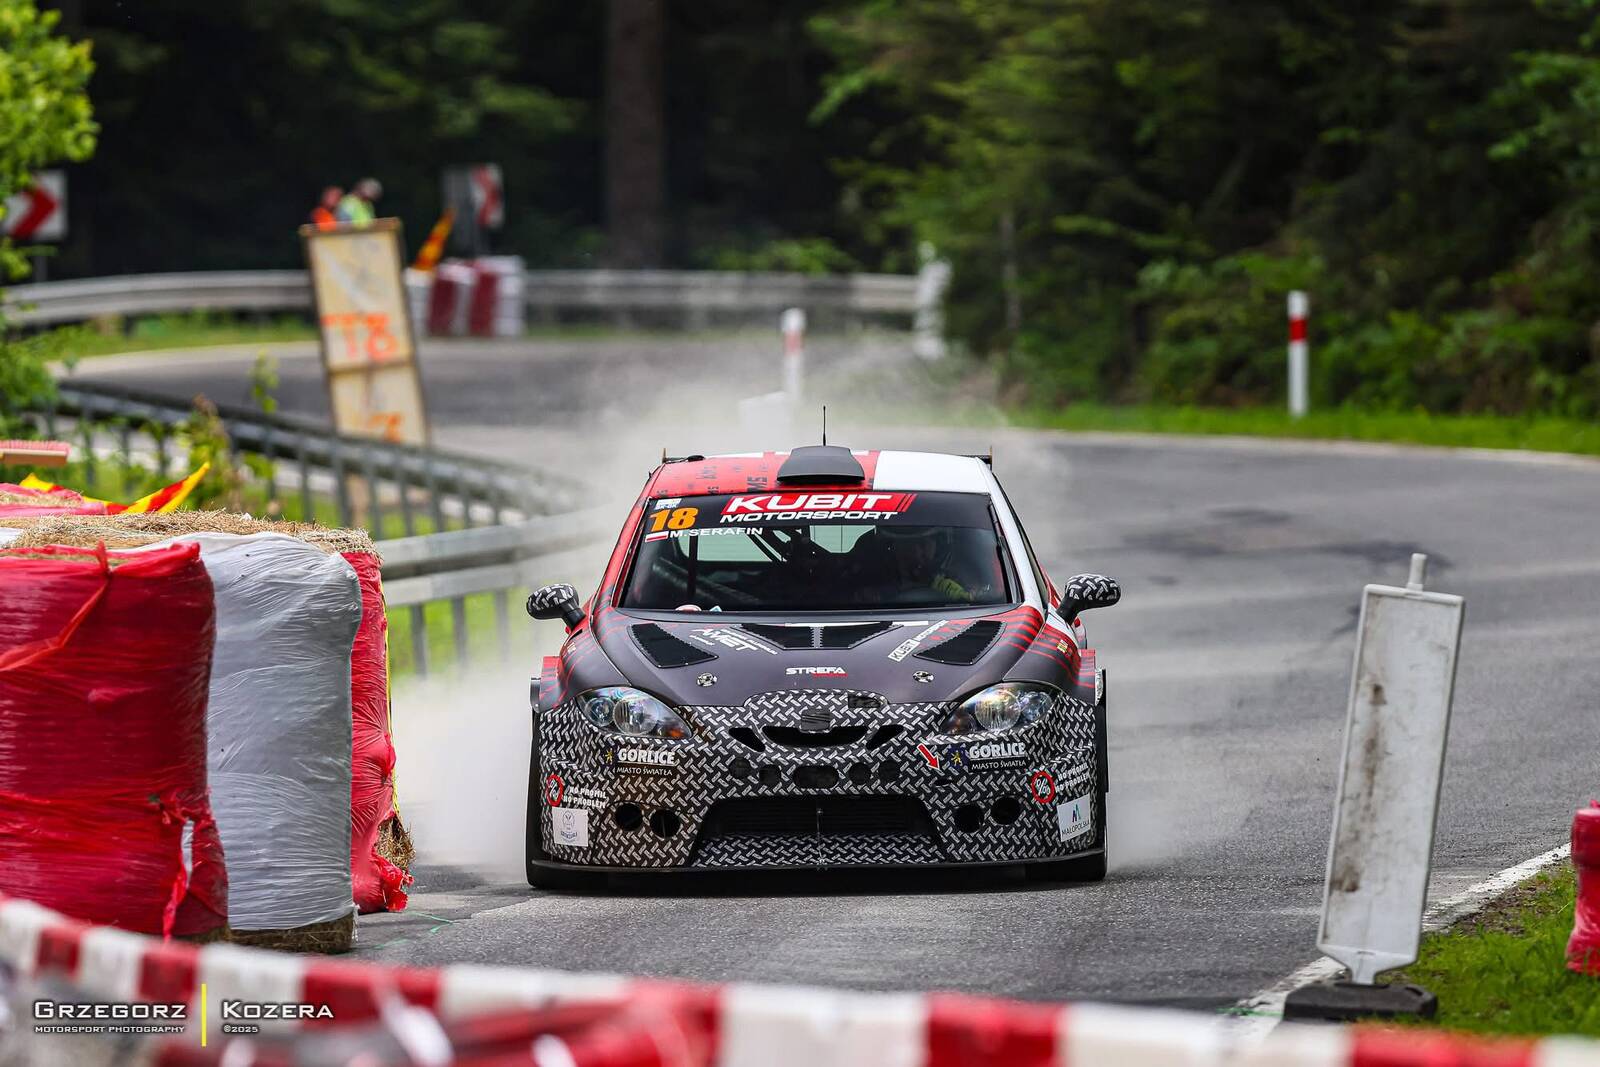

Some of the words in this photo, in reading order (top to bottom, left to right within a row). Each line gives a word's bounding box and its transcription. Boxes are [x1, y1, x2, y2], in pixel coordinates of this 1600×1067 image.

[726, 494, 893, 512] KUBIT
[649, 508, 698, 532] 18
[719, 511, 898, 524] MOTORSPORT
[670, 527, 763, 538] M.SERAFIN
[618, 748, 676, 765] GORLICE
[969, 742, 1026, 759] GORLICE
[616, 767, 642, 775] MIASTO
[971, 762, 999, 770] MIASTO
